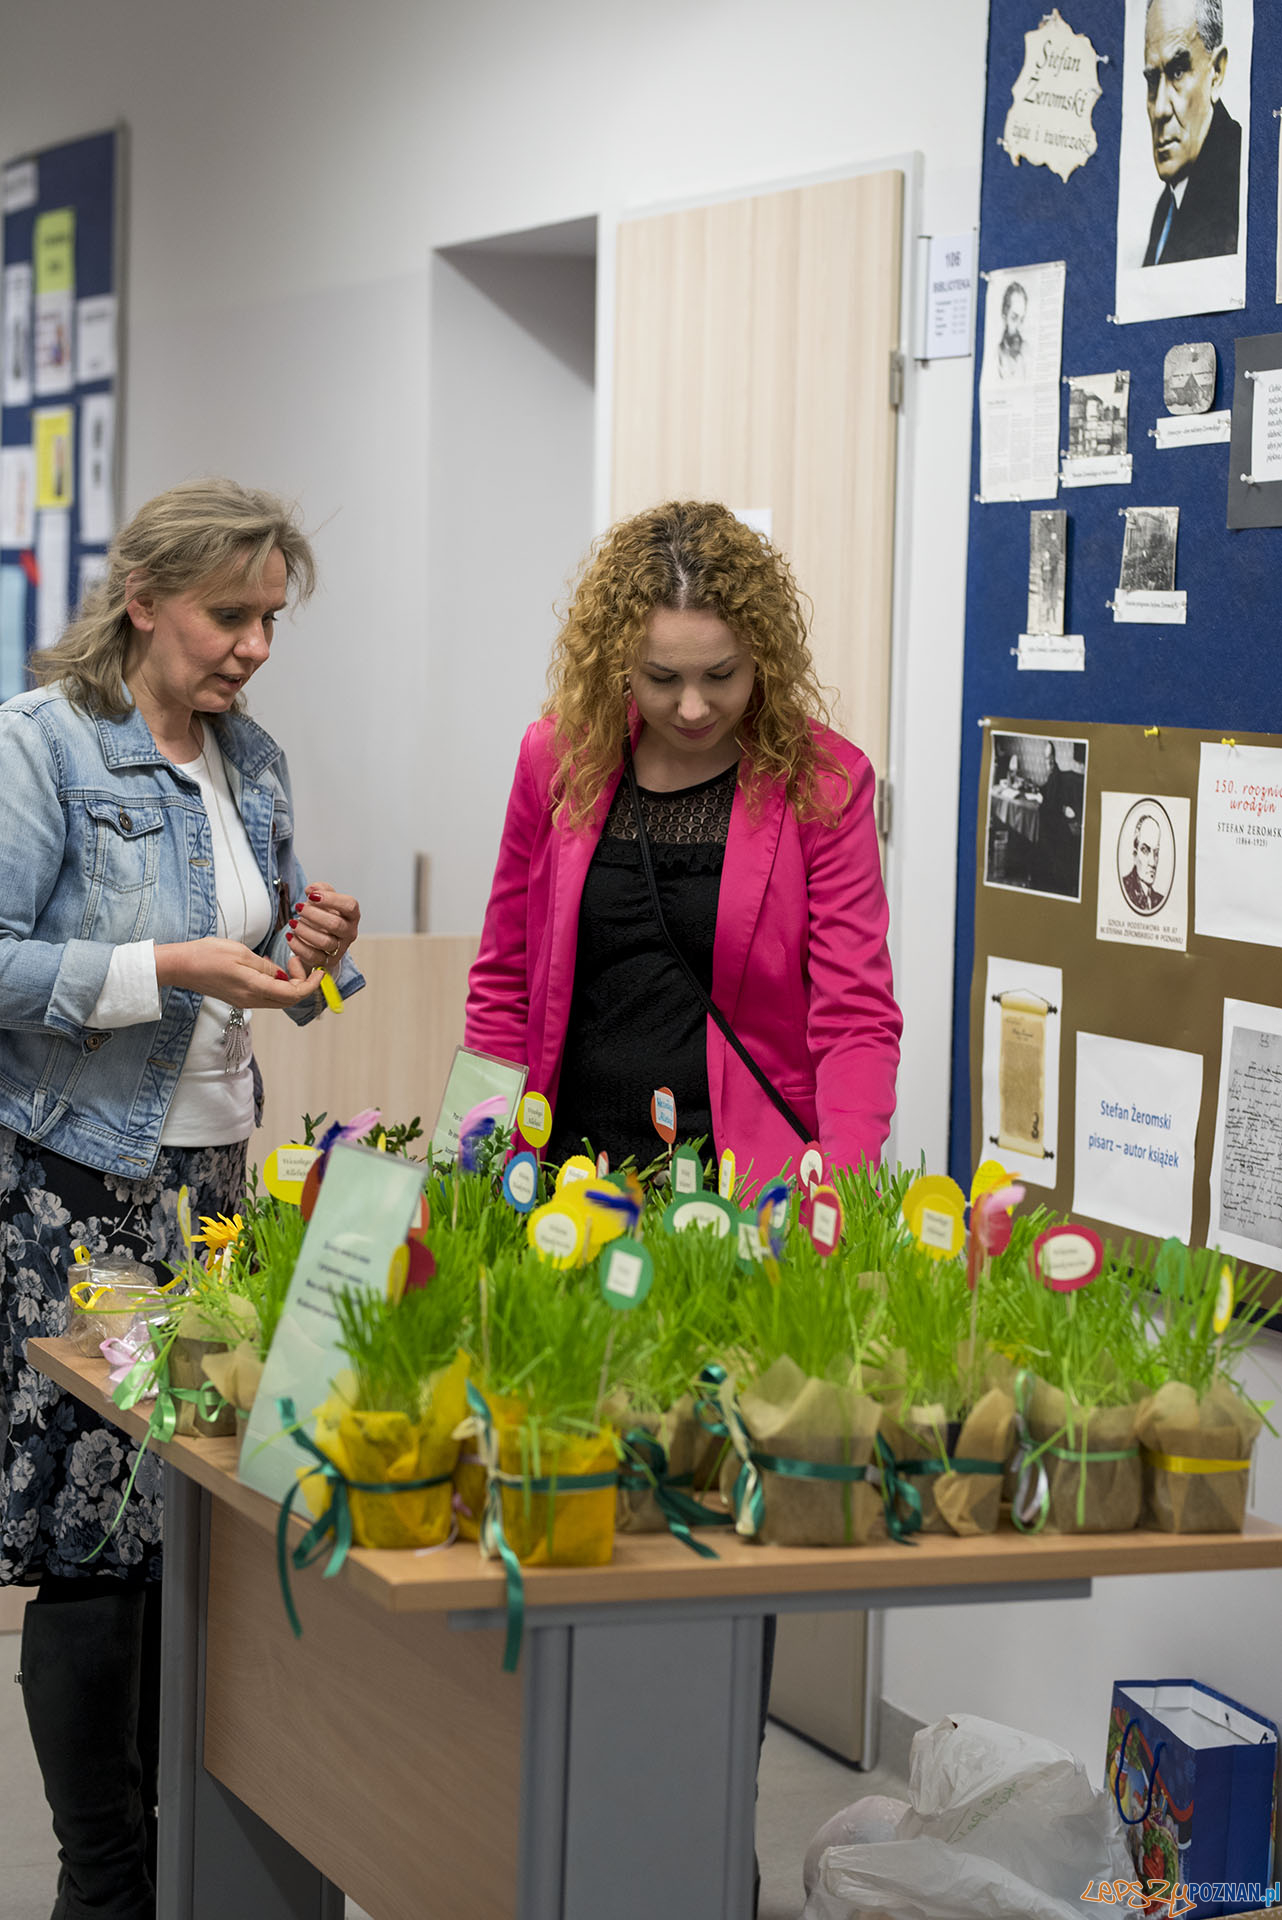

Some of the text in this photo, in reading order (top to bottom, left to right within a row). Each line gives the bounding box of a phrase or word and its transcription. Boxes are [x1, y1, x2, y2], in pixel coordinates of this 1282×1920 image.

[1035, 39, 1081, 77] Stefan
[1023, 70, 1088, 118] Żeromski
[1215, 779, 1238, 795] 150.
[1229, 796, 1277, 817] urodzin
[1217, 821, 1245, 835] STEFAN
[1100, 1100, 1172, 1130] Stefan Żeromski
[1088, 1132, 1114, 1152] pisarz
[1123, 1142, 1147, 1159] autor
[1147, 1144, 1179, 1169] książek
